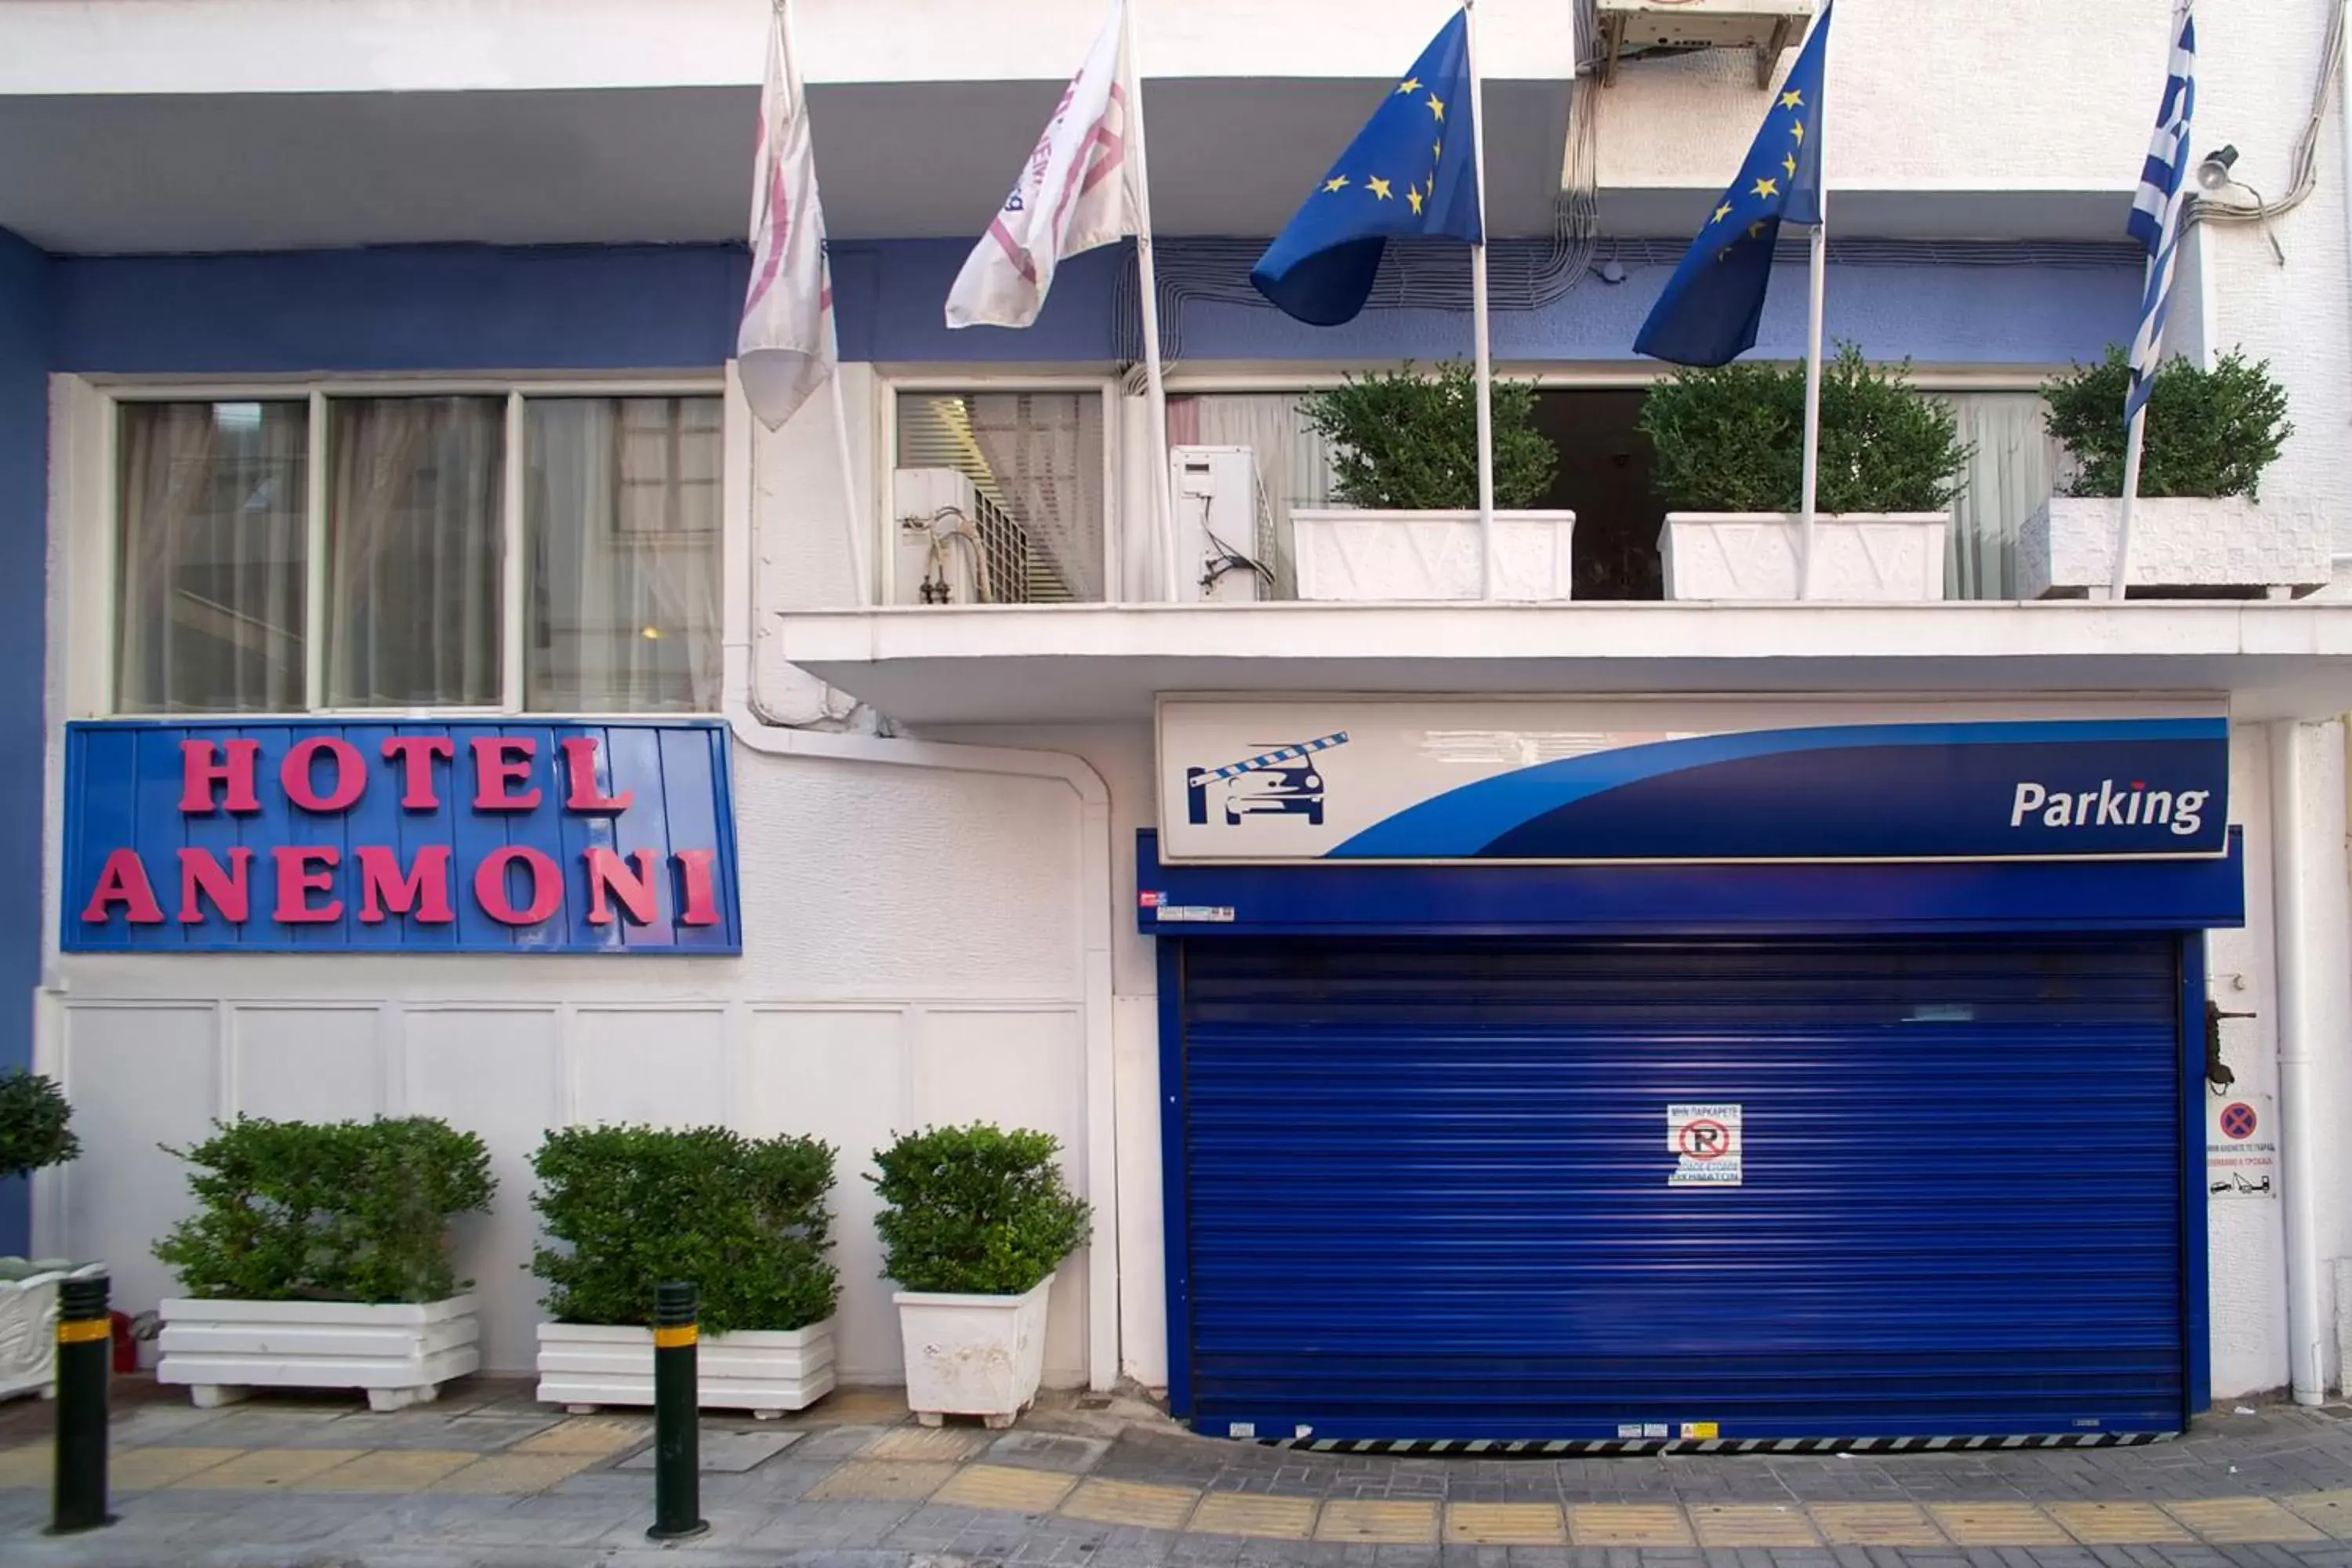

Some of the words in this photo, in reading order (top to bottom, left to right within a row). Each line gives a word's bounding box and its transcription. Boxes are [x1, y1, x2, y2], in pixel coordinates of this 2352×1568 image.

[179, 736, 630, 817] HOTEL
[2010, 779, 2210, 835] Parking
[81, 844, 721, 926] ANEMONI
